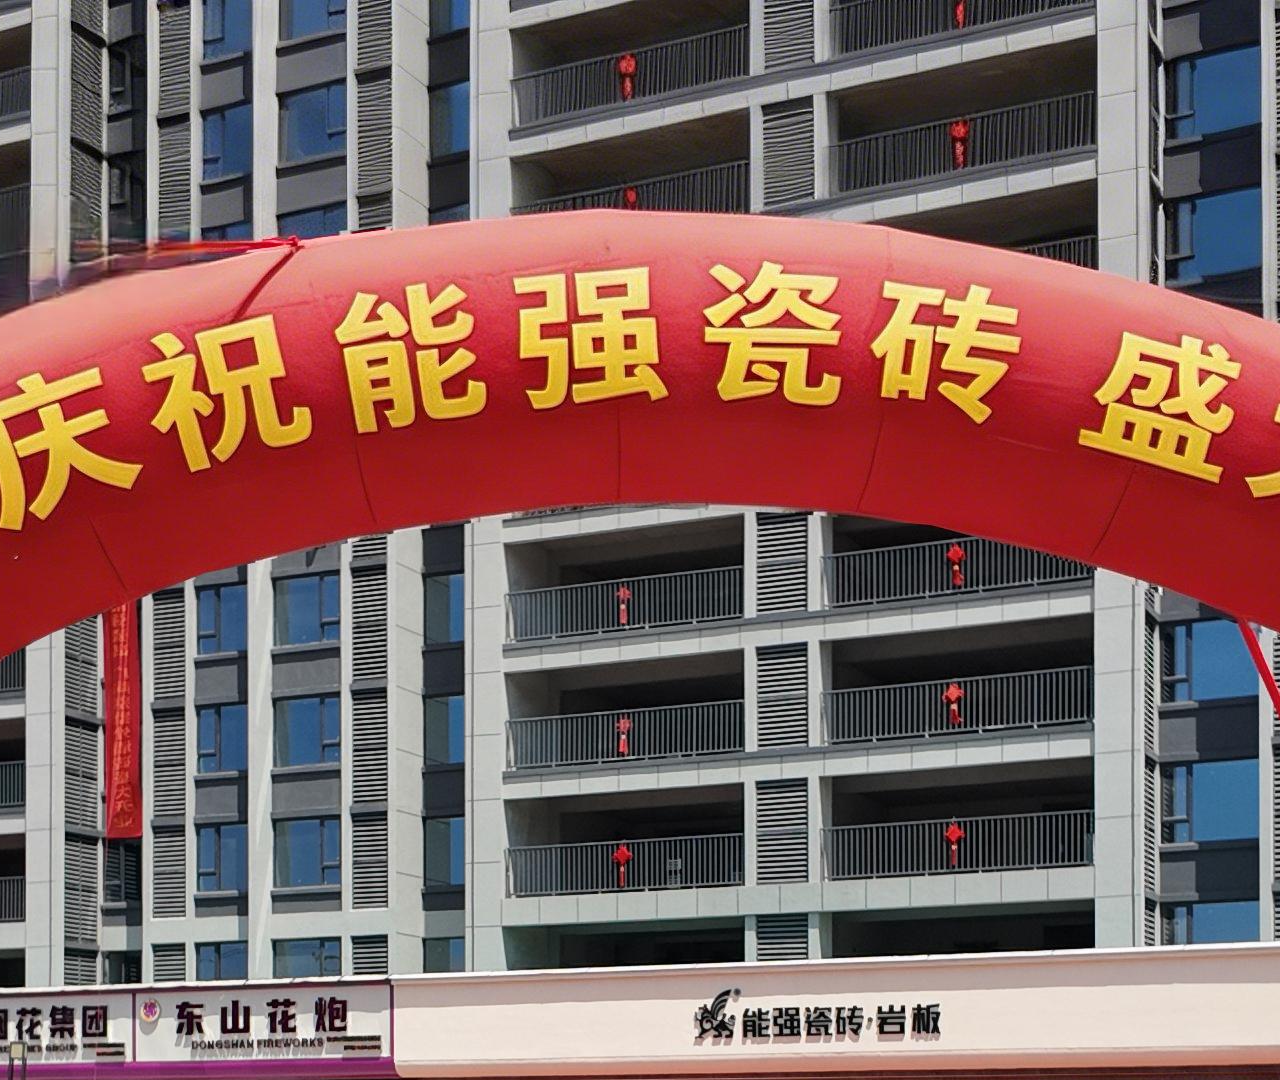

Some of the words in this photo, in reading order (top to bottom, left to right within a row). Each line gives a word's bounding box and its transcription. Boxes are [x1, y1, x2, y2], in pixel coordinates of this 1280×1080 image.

[176, 997, 347, 1034] 东山花炮
[191, 1039, 253, 1050] DONGSHAN
[257, 1037, 324, 1049] FIREWORKS
